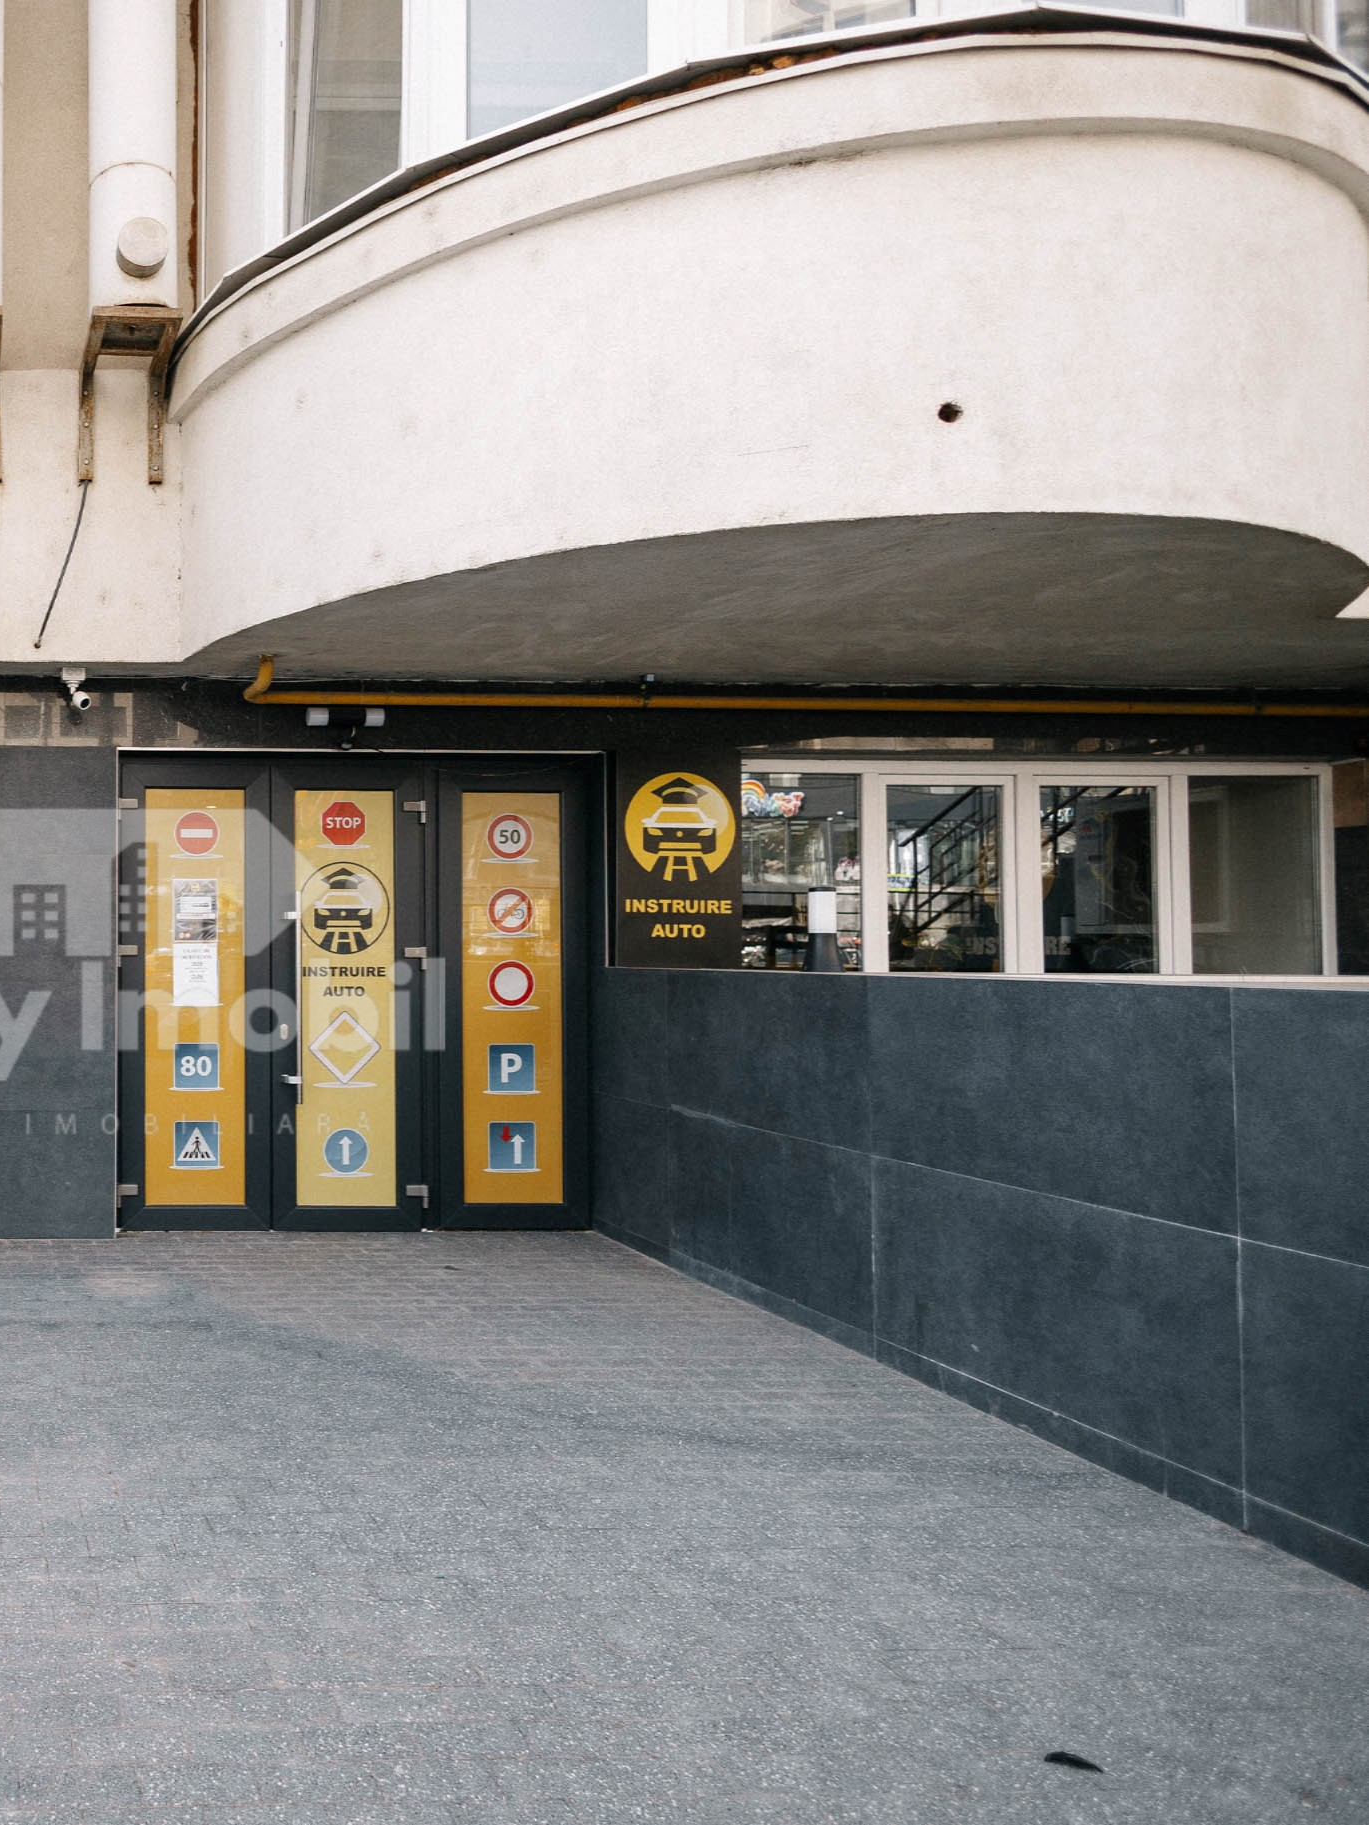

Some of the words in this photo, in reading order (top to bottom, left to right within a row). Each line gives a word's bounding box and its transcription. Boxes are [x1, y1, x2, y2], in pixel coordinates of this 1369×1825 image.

[326, 817, 361, 829] STOP
[499, 829, 521, 844] 50
[625, 899, 732, 914] INSTRUIRE
[651, 923, 706, 938] AUTO
[302, 966, 386, 977] INSTRUIRE
[323, 986, 365, 997] AUTO
[180, 1055, 212, 1077] 80
[501, 1053, 522, 1083] P
